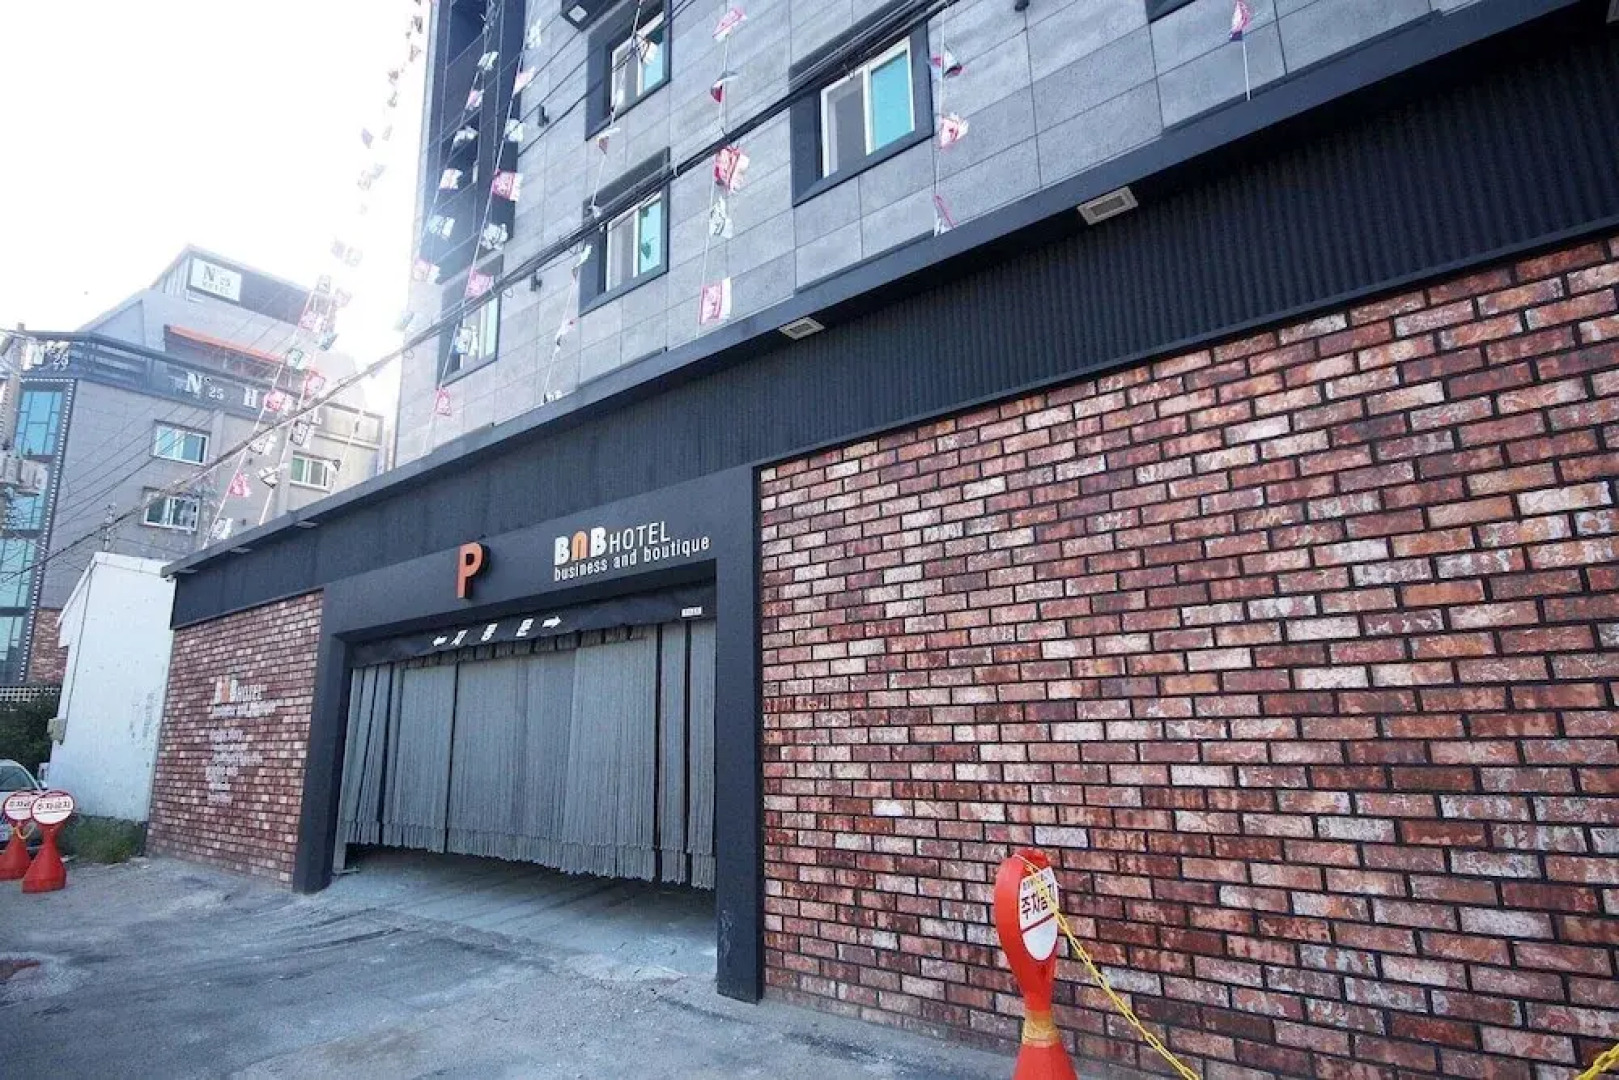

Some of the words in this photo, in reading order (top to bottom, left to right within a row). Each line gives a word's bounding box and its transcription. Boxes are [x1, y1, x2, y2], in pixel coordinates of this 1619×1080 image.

[554, 557, 608, 582] business
[613, 548, 637, 569] and
[643, 536, 710, 563] boutique
[609, 520, 670, 554] HOTEL
[456, 541, 486, 599] P
